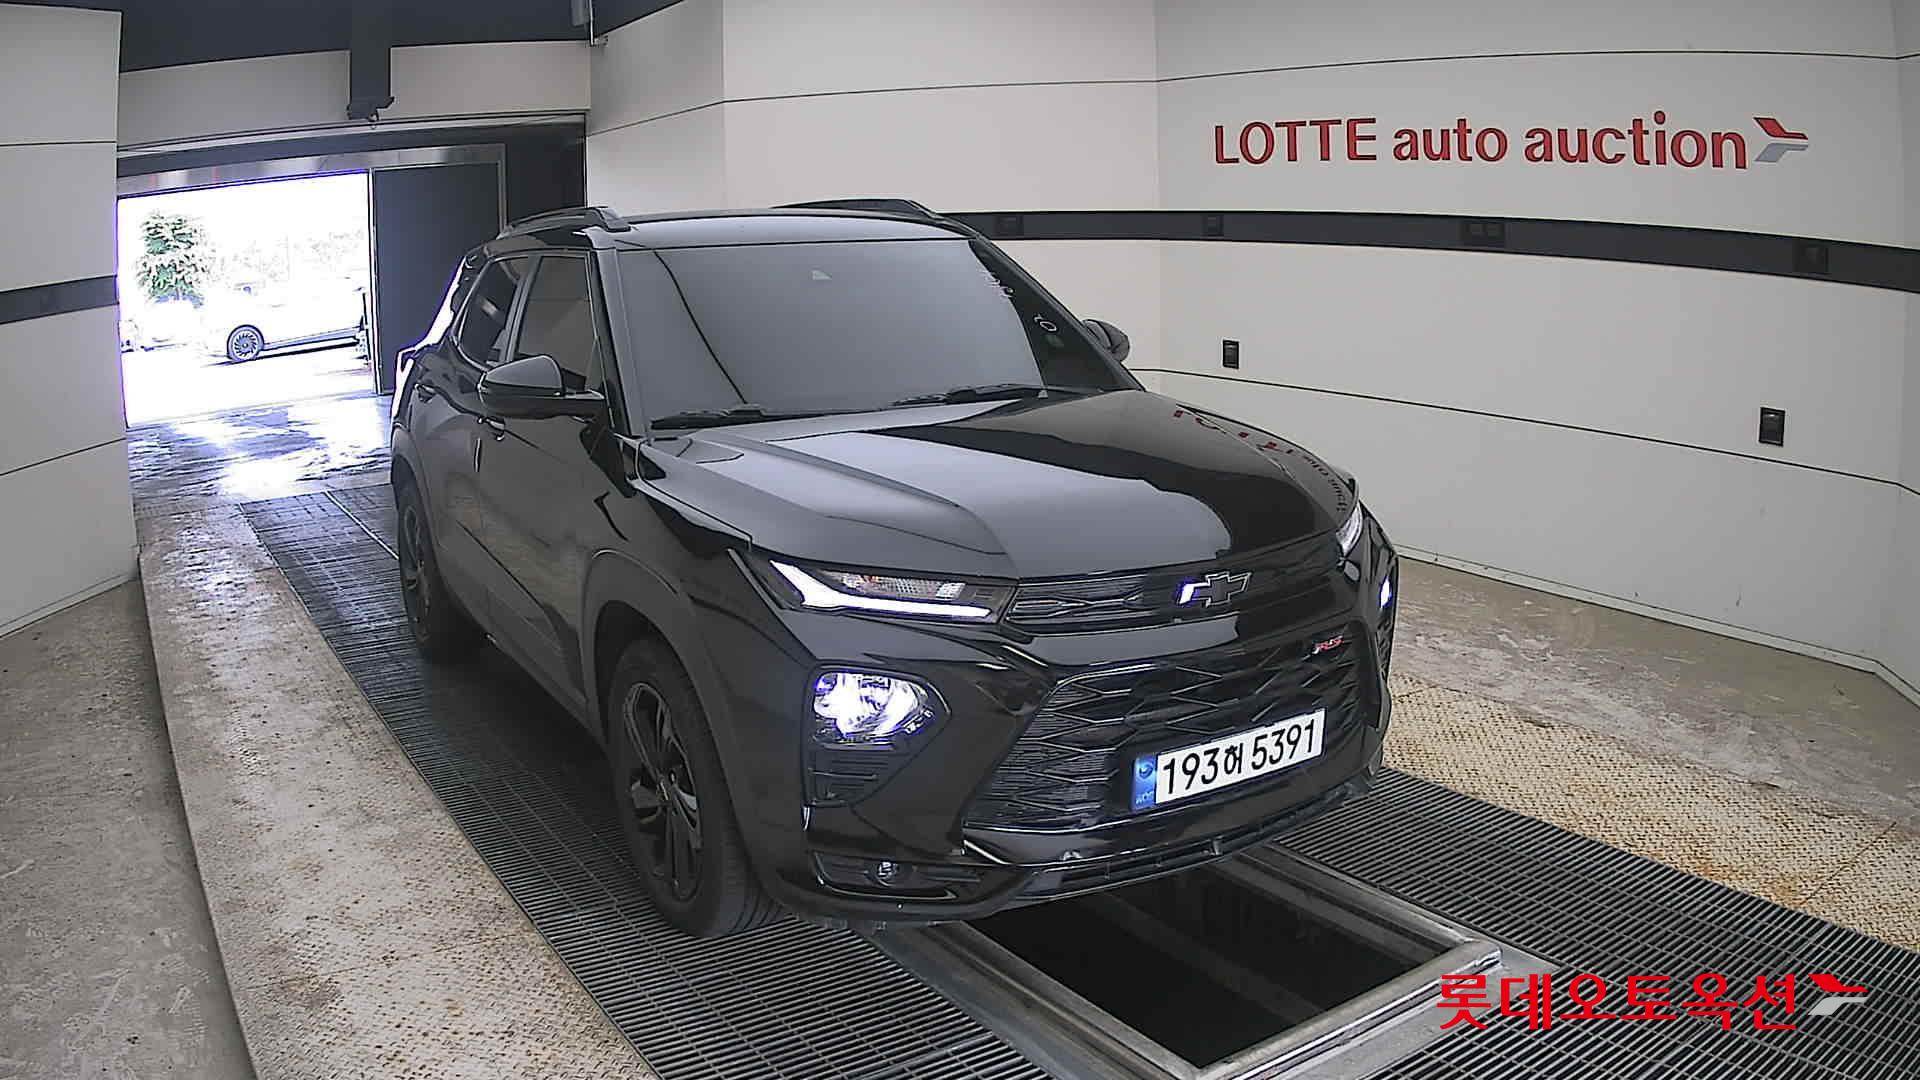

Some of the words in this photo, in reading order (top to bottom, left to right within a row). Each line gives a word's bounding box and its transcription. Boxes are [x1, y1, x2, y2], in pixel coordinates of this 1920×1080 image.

[1214, 118, 1377, 164] LOTTE
[1392, 118, 1508, 162] auto
[1523, 110, 1748, 169] auction
[1311, 635, 1344, 655] RS
[1251, 718, 1315, 770] 5391
